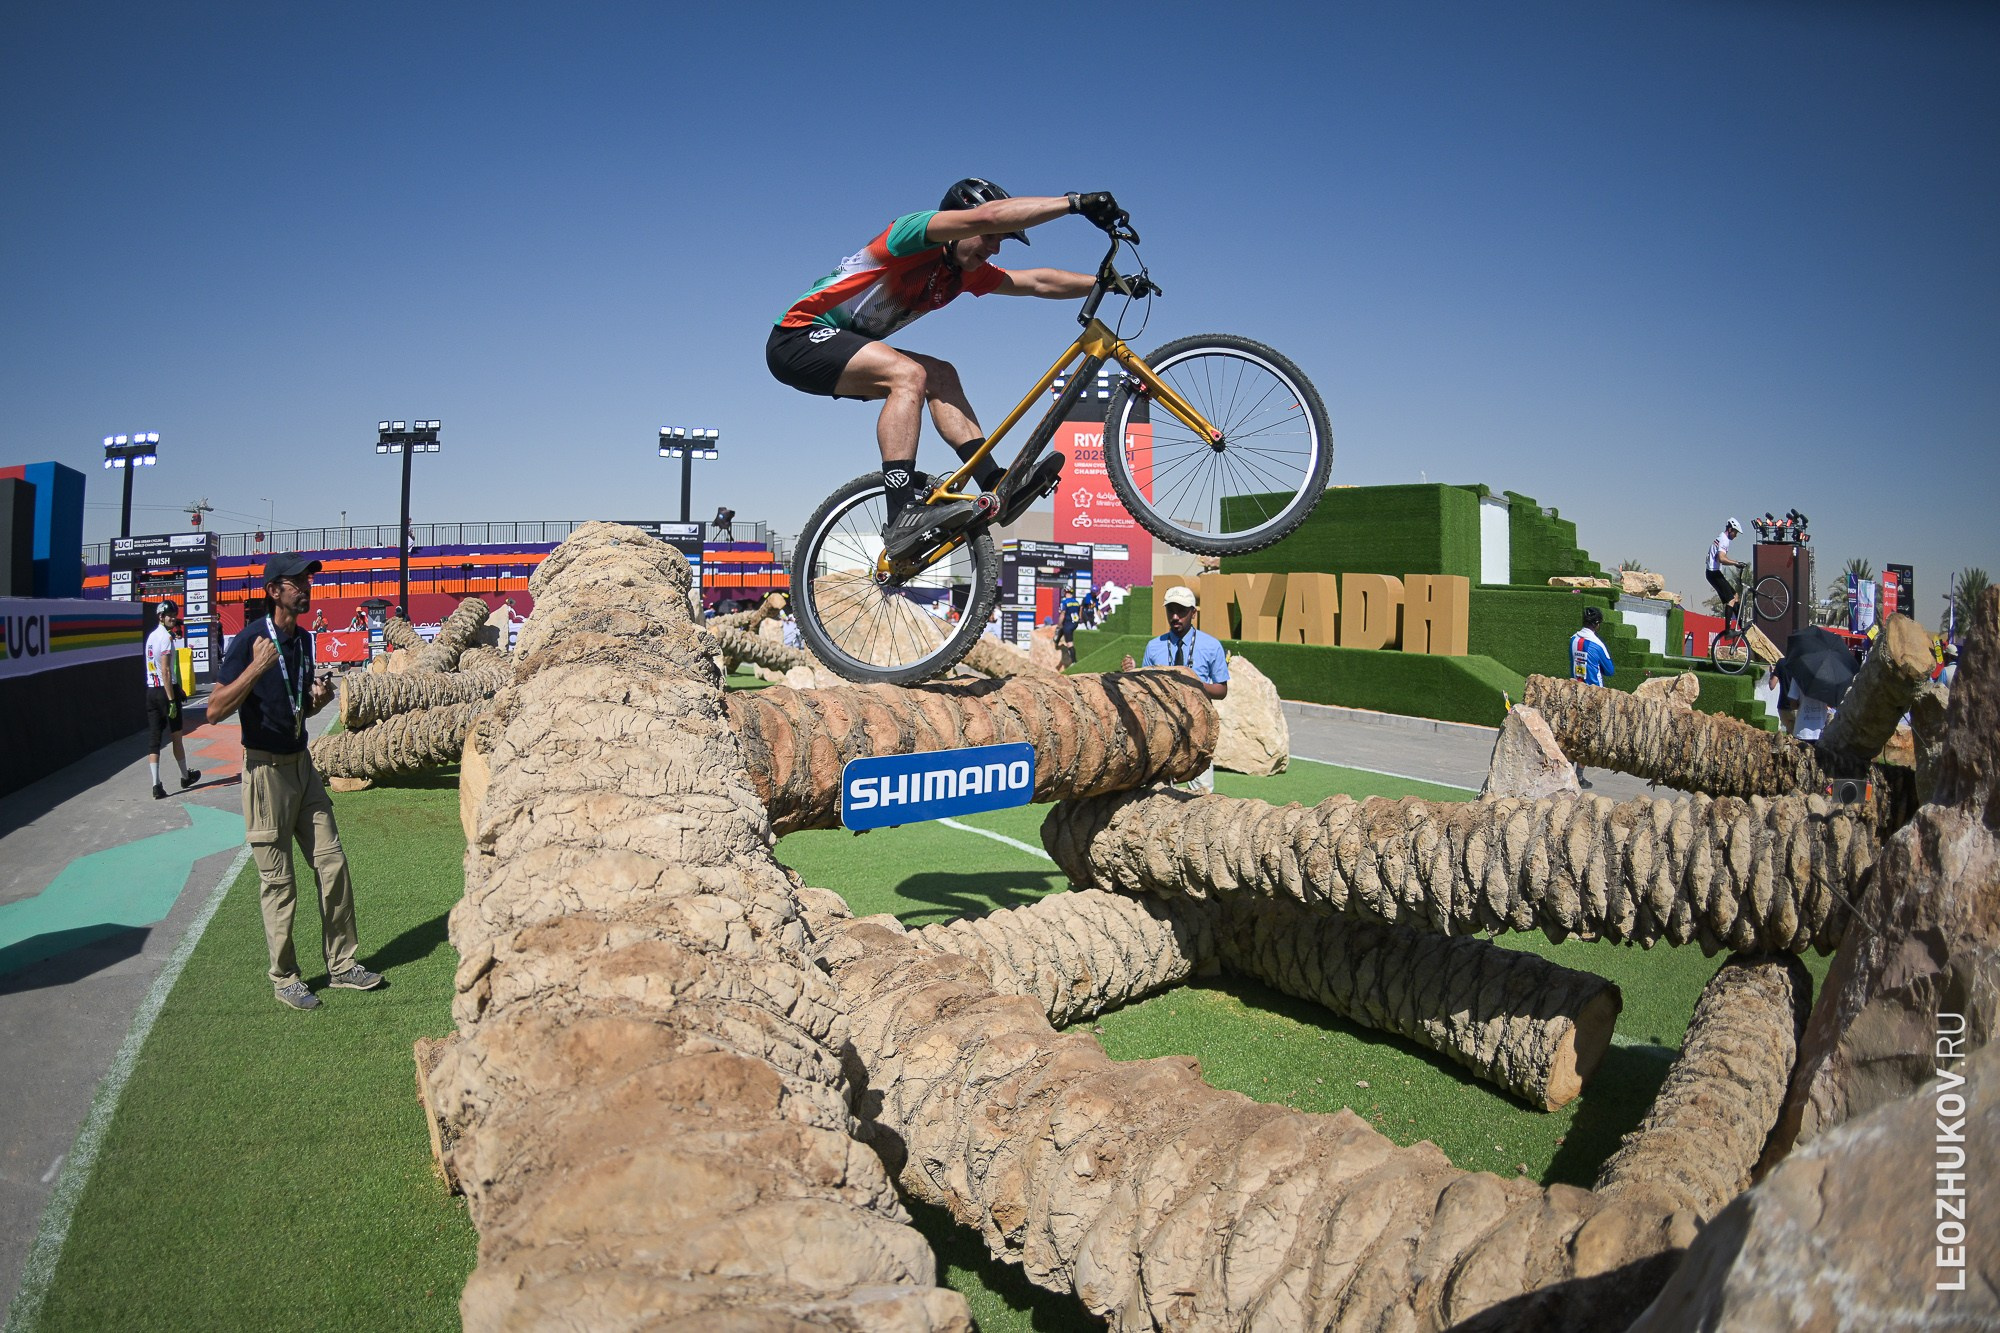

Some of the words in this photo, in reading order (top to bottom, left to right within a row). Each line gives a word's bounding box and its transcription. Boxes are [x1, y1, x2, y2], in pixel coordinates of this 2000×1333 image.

[118, 540, 132, 549] UCI
[115, 572, 130, 580] UCI
[7, 614, 46, 659] UCI
[850, 760, 1030, 811] SHIMANO
